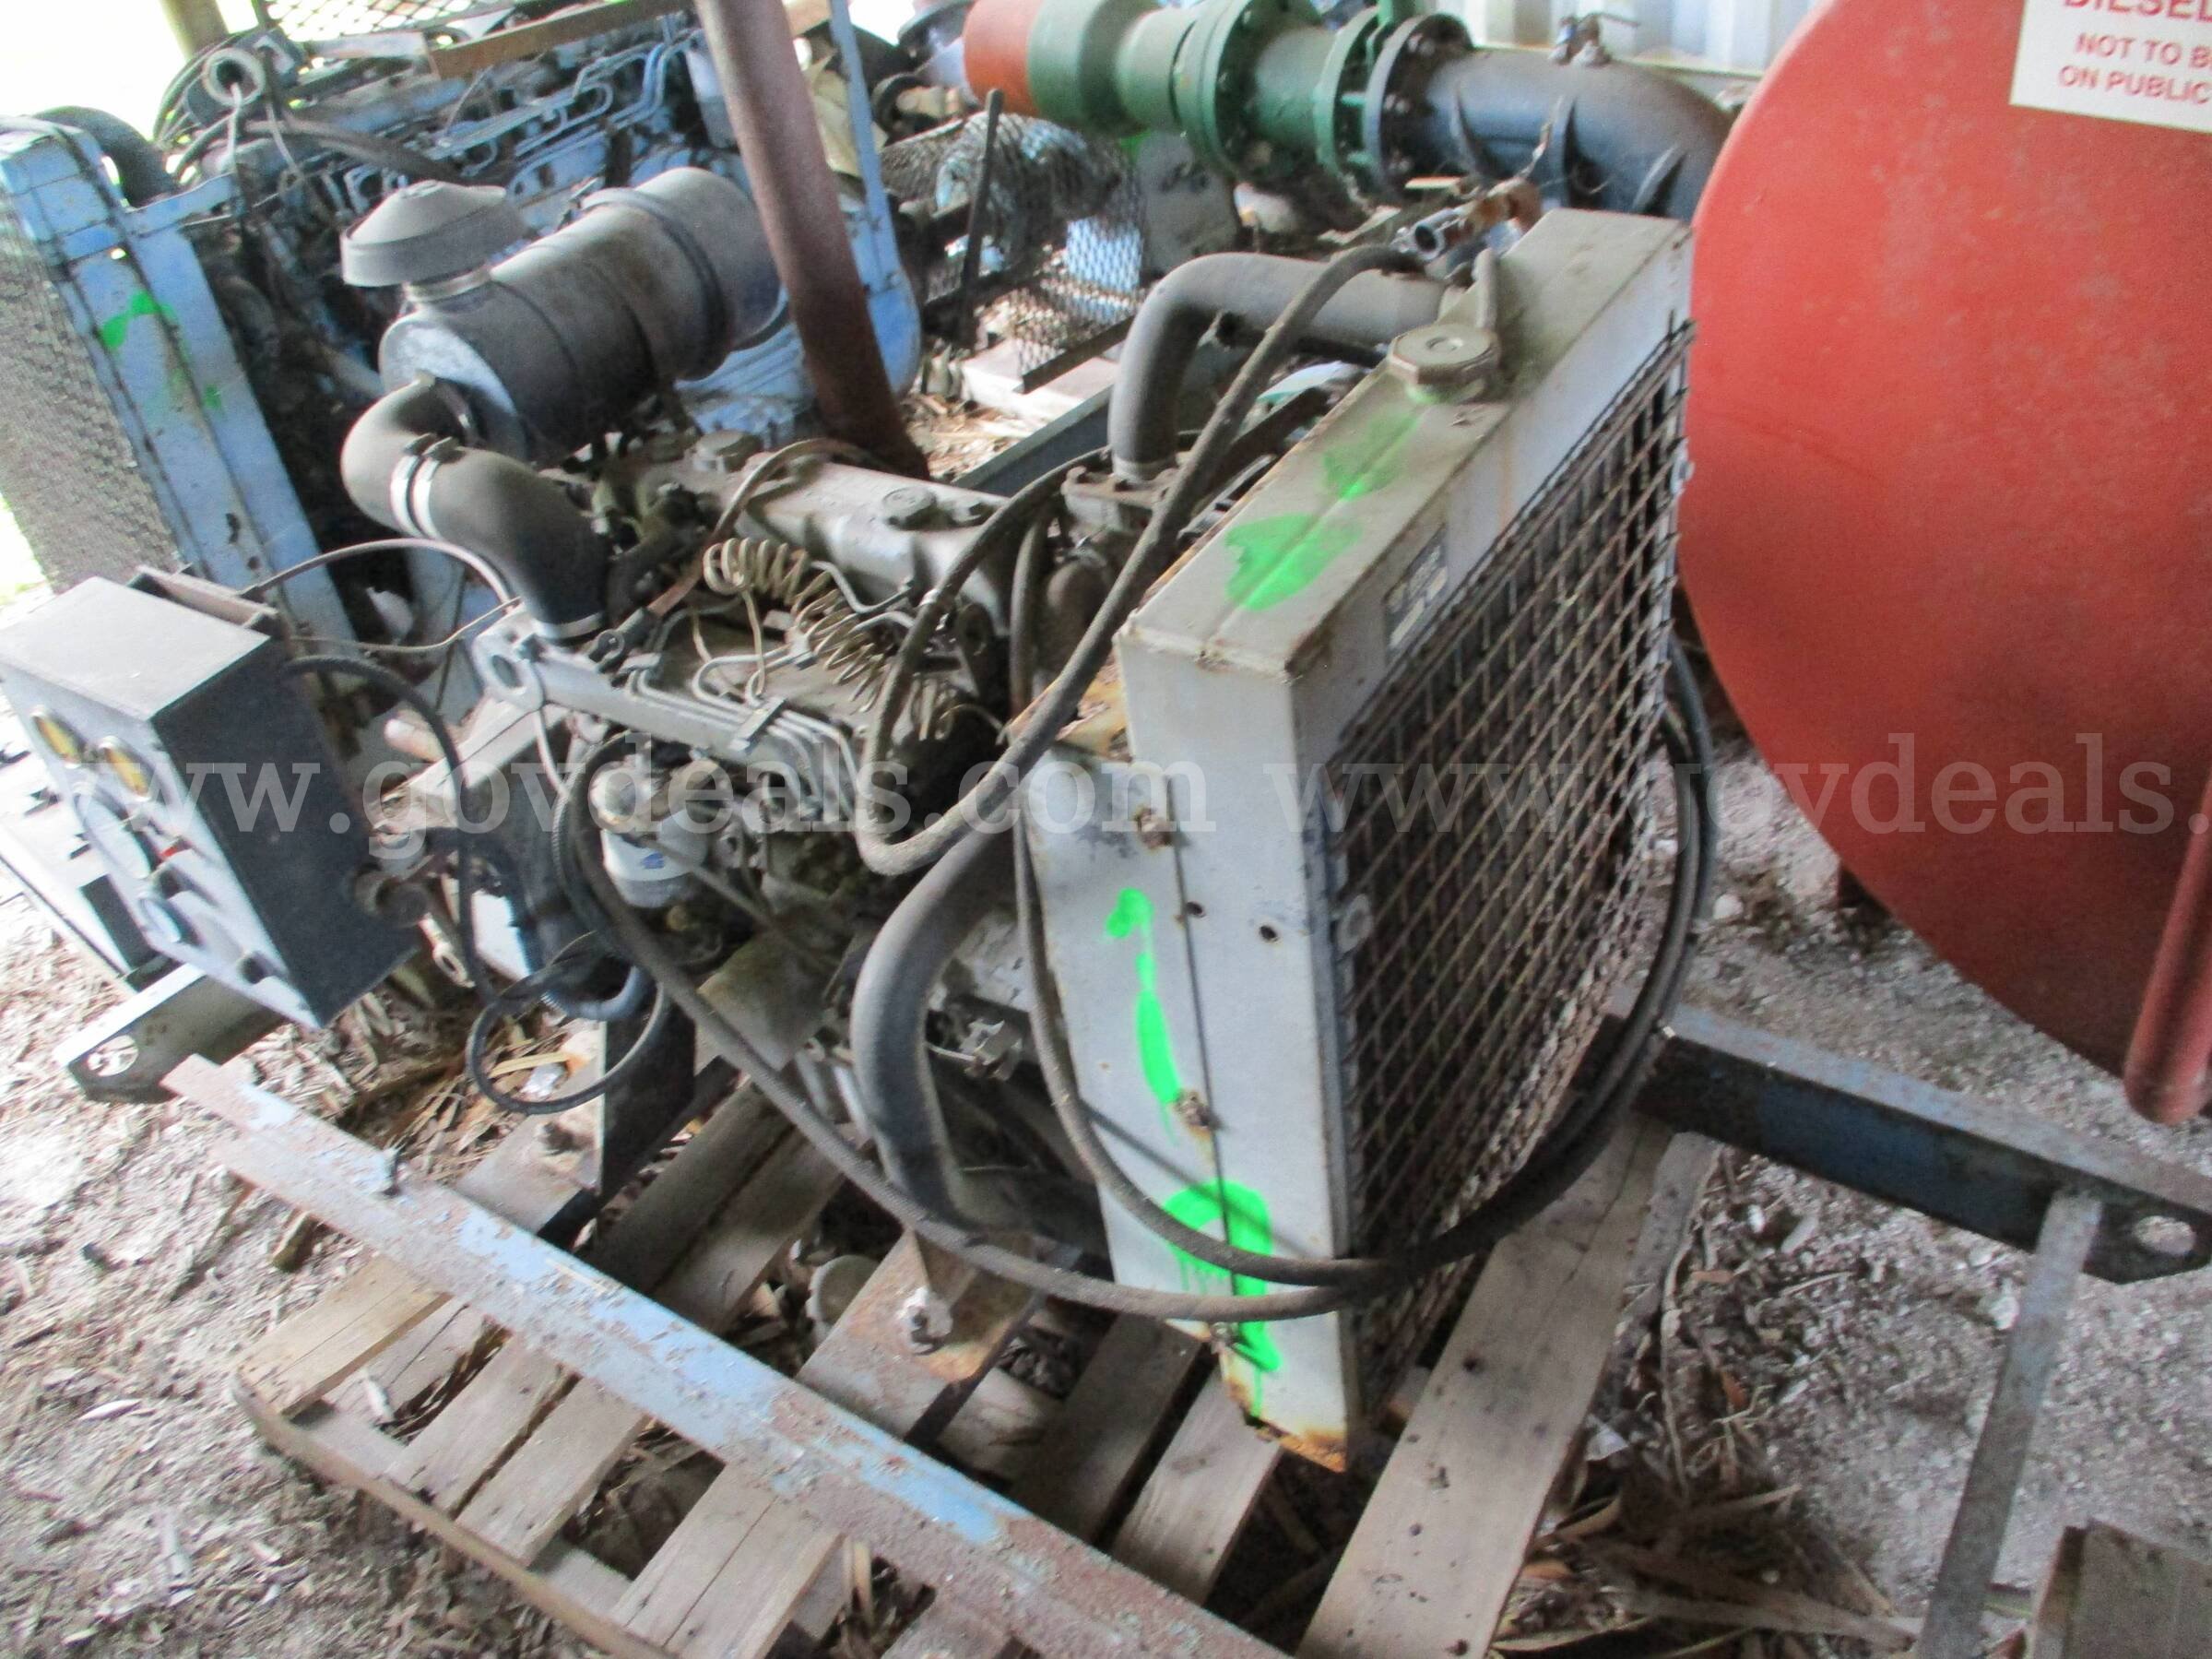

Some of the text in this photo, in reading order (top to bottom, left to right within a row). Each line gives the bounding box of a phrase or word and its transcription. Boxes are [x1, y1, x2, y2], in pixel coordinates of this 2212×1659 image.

[2076, 32, 2136, 60] NOT
[2144, 40, 2183, 66] TO
[2058, 65, 2212, 105] ON PUBLIC
